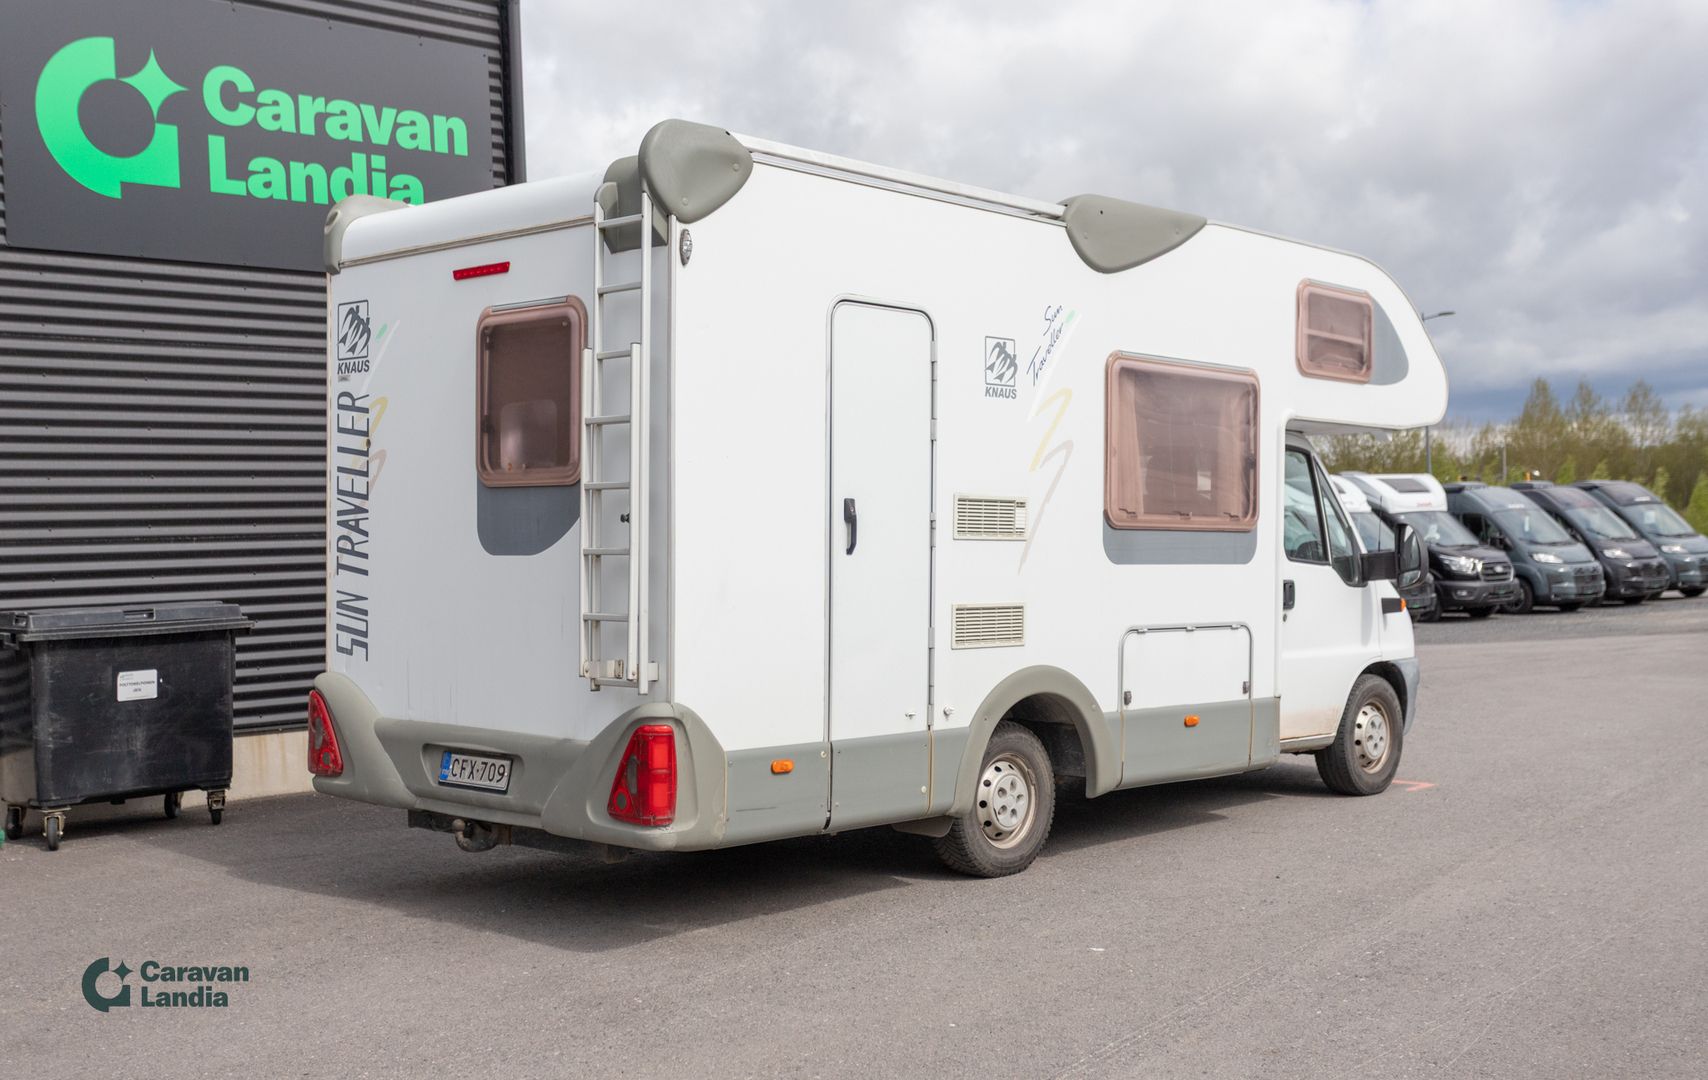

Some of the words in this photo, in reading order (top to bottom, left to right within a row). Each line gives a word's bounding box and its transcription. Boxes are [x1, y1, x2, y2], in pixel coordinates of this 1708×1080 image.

[202, 65, 469, 157] Caravan
[208, 134, 425, 206] Landia
[1043, 305, 1063, 336] Sun
[337, 360, 370, 375] KNAUS
[1026, 322, 1063, 387] Traveller
[984, 386, 1017, 400] KNAUS
[336, 391, 370, 577] TRAVELLER
[336, 589, 369, 662] SUN
[451, 758, 506, 783] CFX-709
